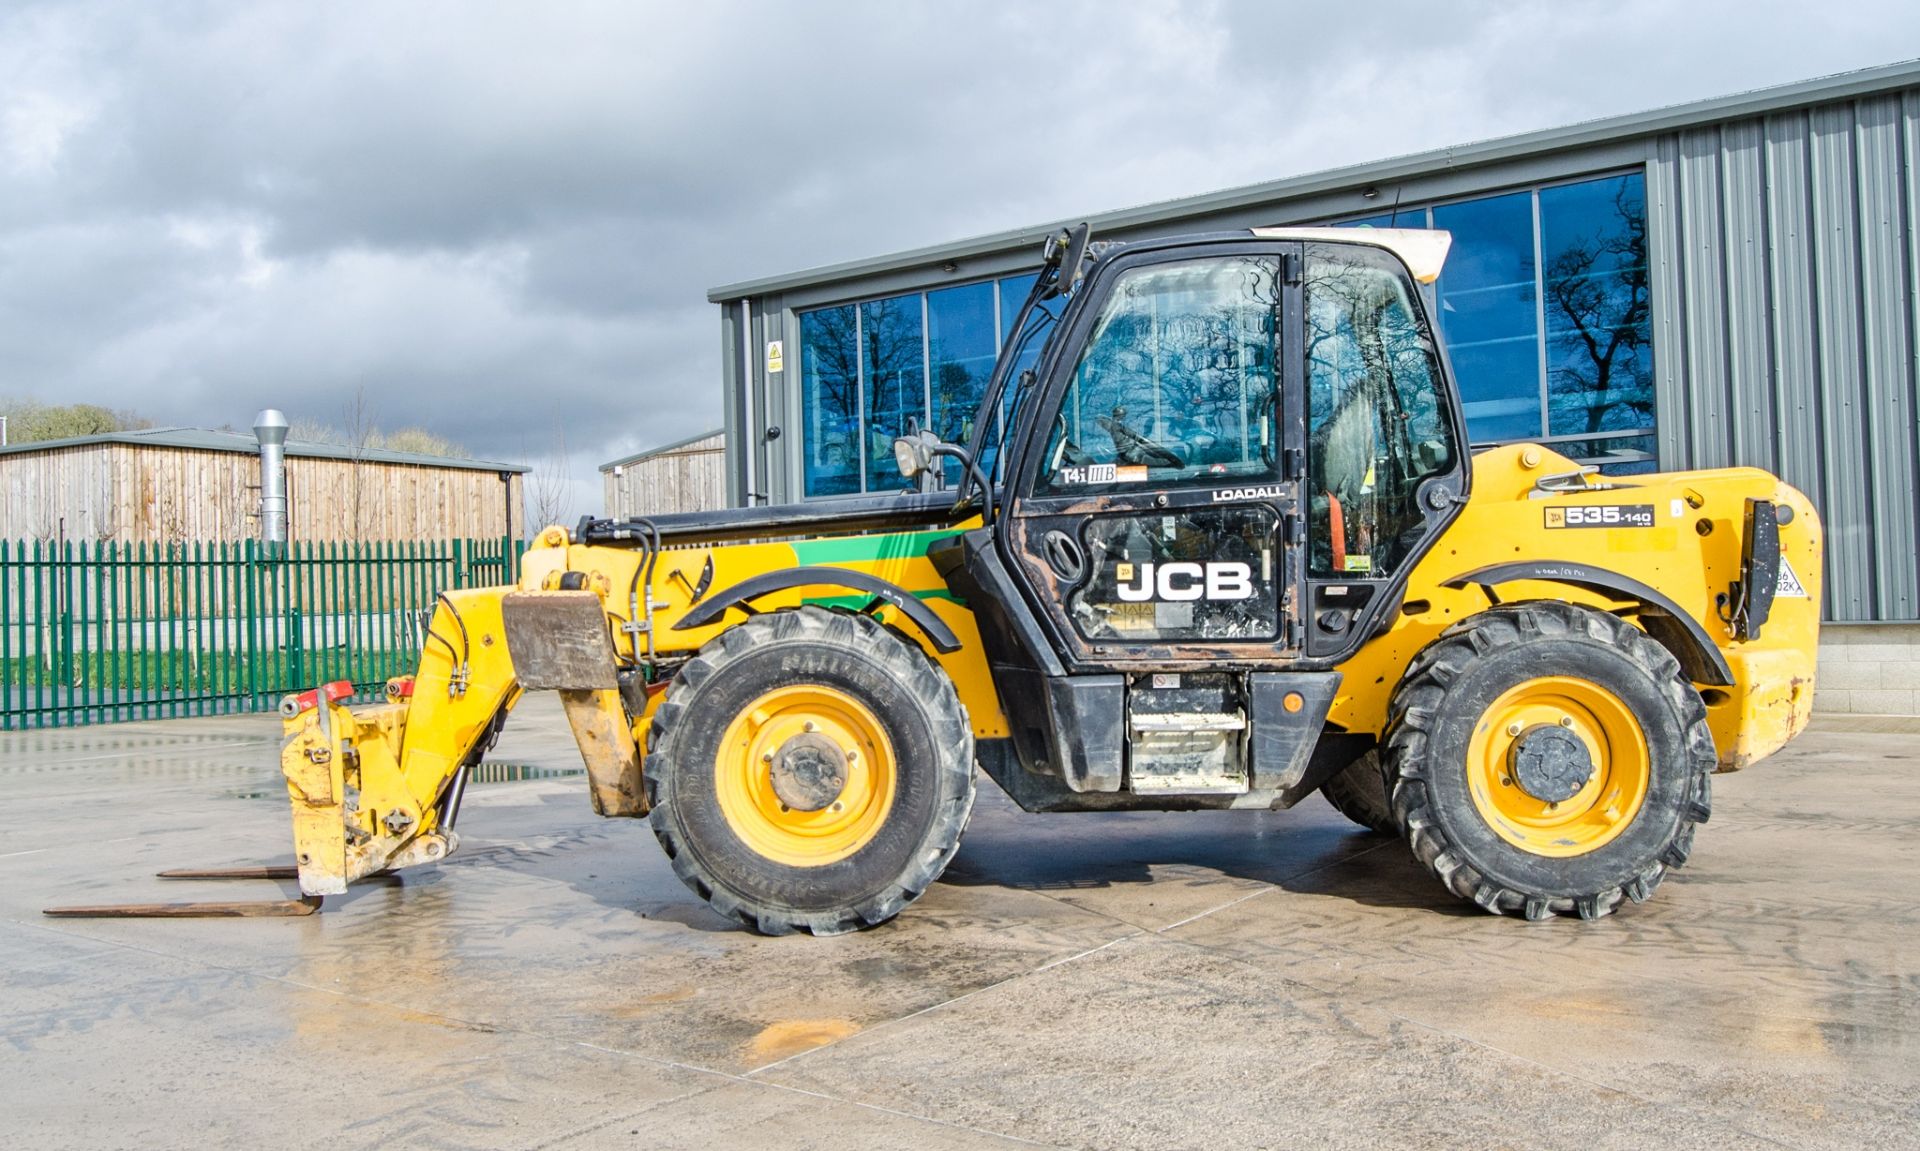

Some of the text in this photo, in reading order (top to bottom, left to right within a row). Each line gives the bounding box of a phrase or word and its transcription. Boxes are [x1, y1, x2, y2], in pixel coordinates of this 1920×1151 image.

[1060, 467, 1087, 484] T4i
[1212, 486, 1285, 501] LOADALL
[1117, 562, 1252, 601] JCB
